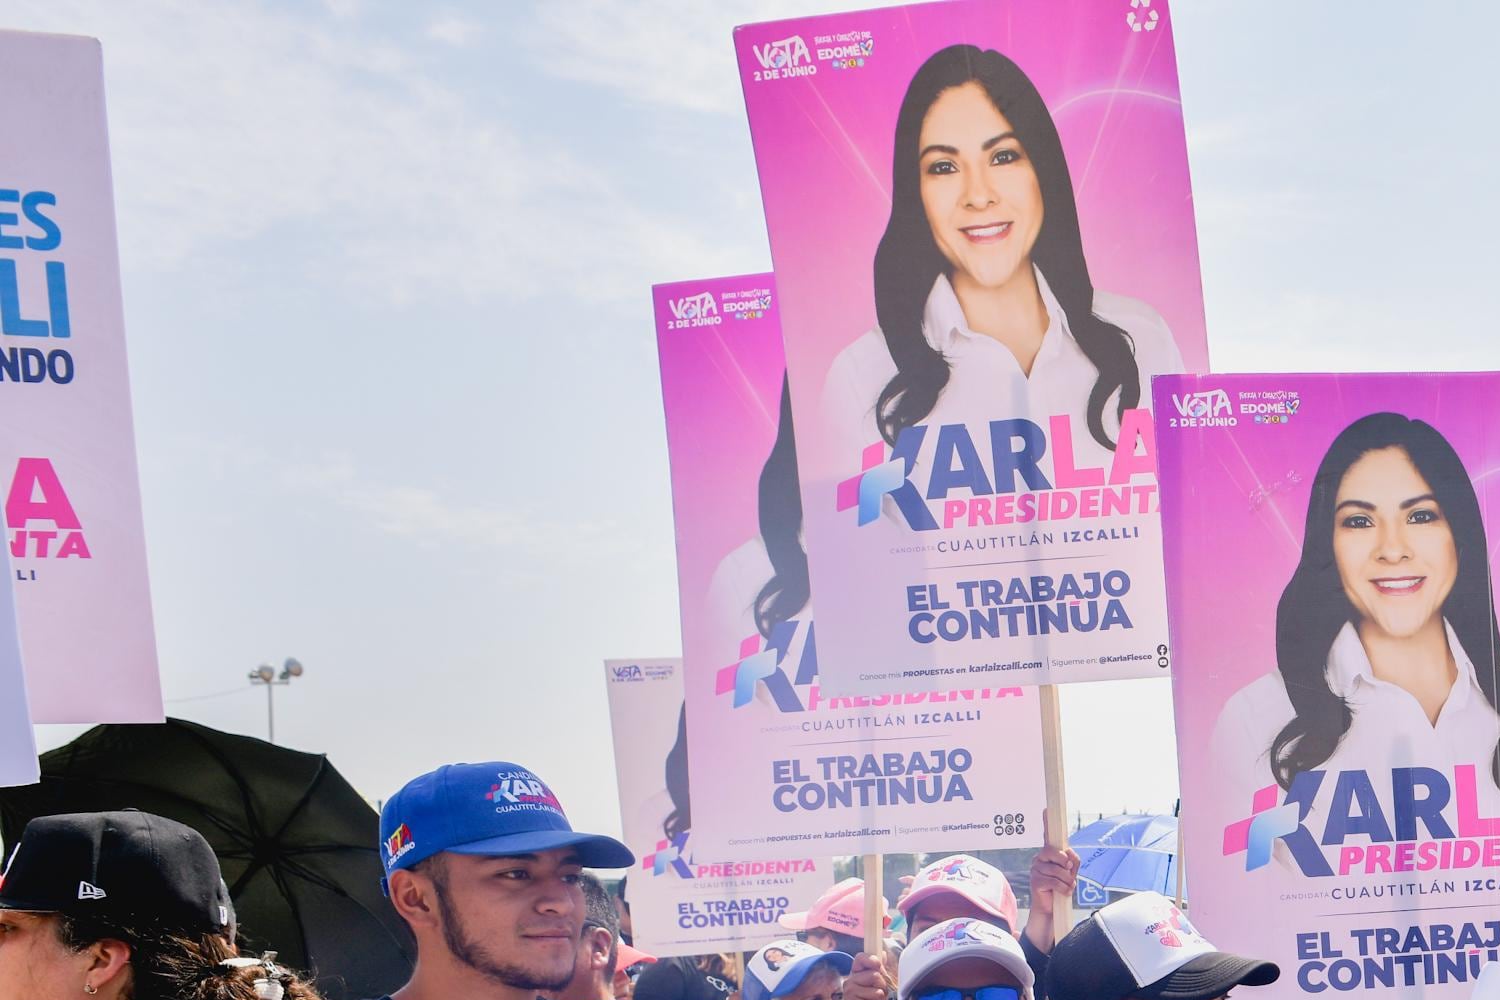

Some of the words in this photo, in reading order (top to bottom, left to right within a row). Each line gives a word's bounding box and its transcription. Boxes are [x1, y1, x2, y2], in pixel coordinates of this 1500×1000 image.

[752, 35, 811, 69] VOTA
[753, 71, 762, 81] 2
[764, 70, 779, 80] DE
[782, 65, 817, 78] JUNIO
[669, 292, 718, 319] VOTA
[667, 321, 674, 329] 2
[676, 319, 689, 328] DE
[692, 316, 721, 327] JUNIO
[1172, 389, 1233, 418] VOTA
[1169, 418, 1177, 427] 2
[1180, 418, 1197, 427] DE
[1200, 417, 1237, 427] JUNIO
[858, 408, 1158, 532] KARLA
[944, 484, 1160, 529] PRESIDENT
[937, 530, 1053, 553] CUAUTITLÁN
[1063, 526, 1139, 543] IZCALLI
[906, 584, 950, 612] EL
[957, 569, 1131, 608] TRABAJO
[903, 667, 954, 678] PROPUESTAS
[969, 659, 1042, 673] karlaizcalli.com
[802, 715, 906, 733] CUAUTITLÁN
[914, 710, 981, 726] IZCALLI
[772, 760, 810, 784] EL
[817, 748, 973, 780] TRABAJO
[767, 833, 812, 843] PROPUESTAS
[697, 859, 816, 879] PRESIDENTA
[1331, 879, 1456, 900] CUAUTITLÁN
[678, 902, 699, 914] EL
[704, 896, 789, 914] TRABAJO
[1297, 932, 1342, 960] EL
